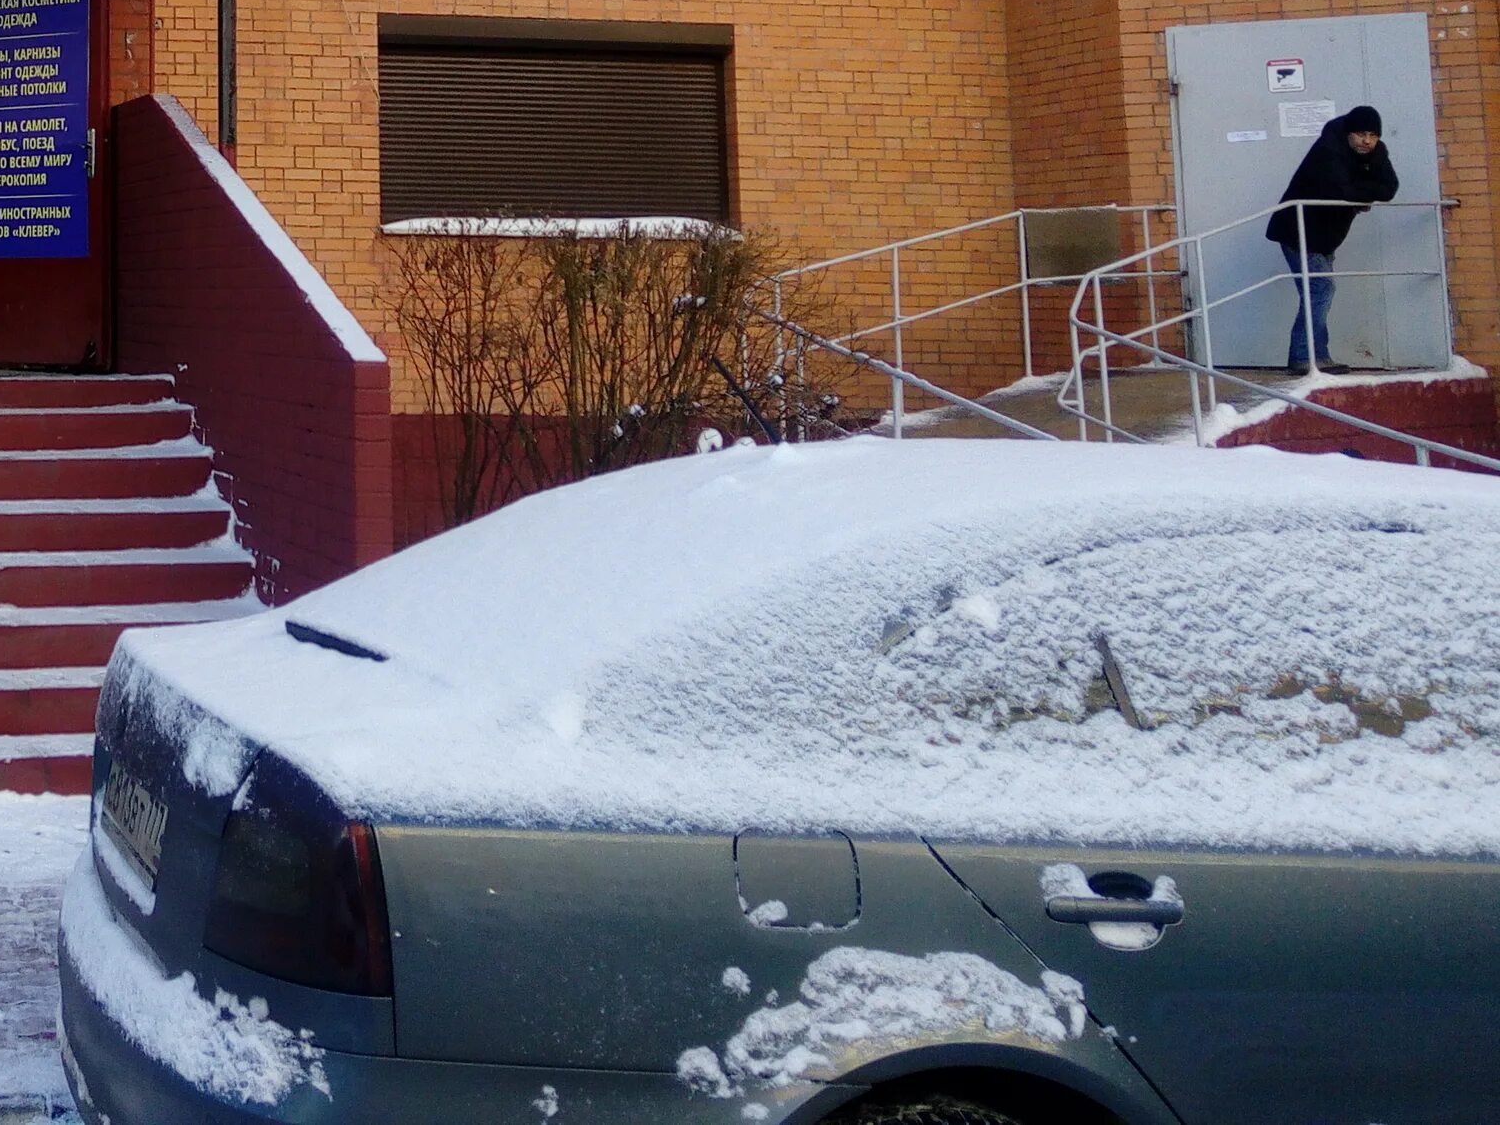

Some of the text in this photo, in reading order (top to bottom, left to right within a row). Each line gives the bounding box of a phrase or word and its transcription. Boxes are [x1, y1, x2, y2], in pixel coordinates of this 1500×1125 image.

[14, 46, 60, 61] КАРНИЗЫ
[15, 64, 59, 79] ОДЕЖДЫ
[20, 82, 66, 96] ПОТОЛКИ
[5, 121, 18, 133] НА
[20, 118, 68, 132] САМОЛЕТ,
[22, 137, 55, 151] ПОЕЗД
[9, 155, 40, 168] ВСЕМУ
[43, 154, 72, 167] МИРУ
[0, 206, 71, 220] ИНОСТРАННЫХ
[12, 225, 60, 238] «КЛЕВЕР»
